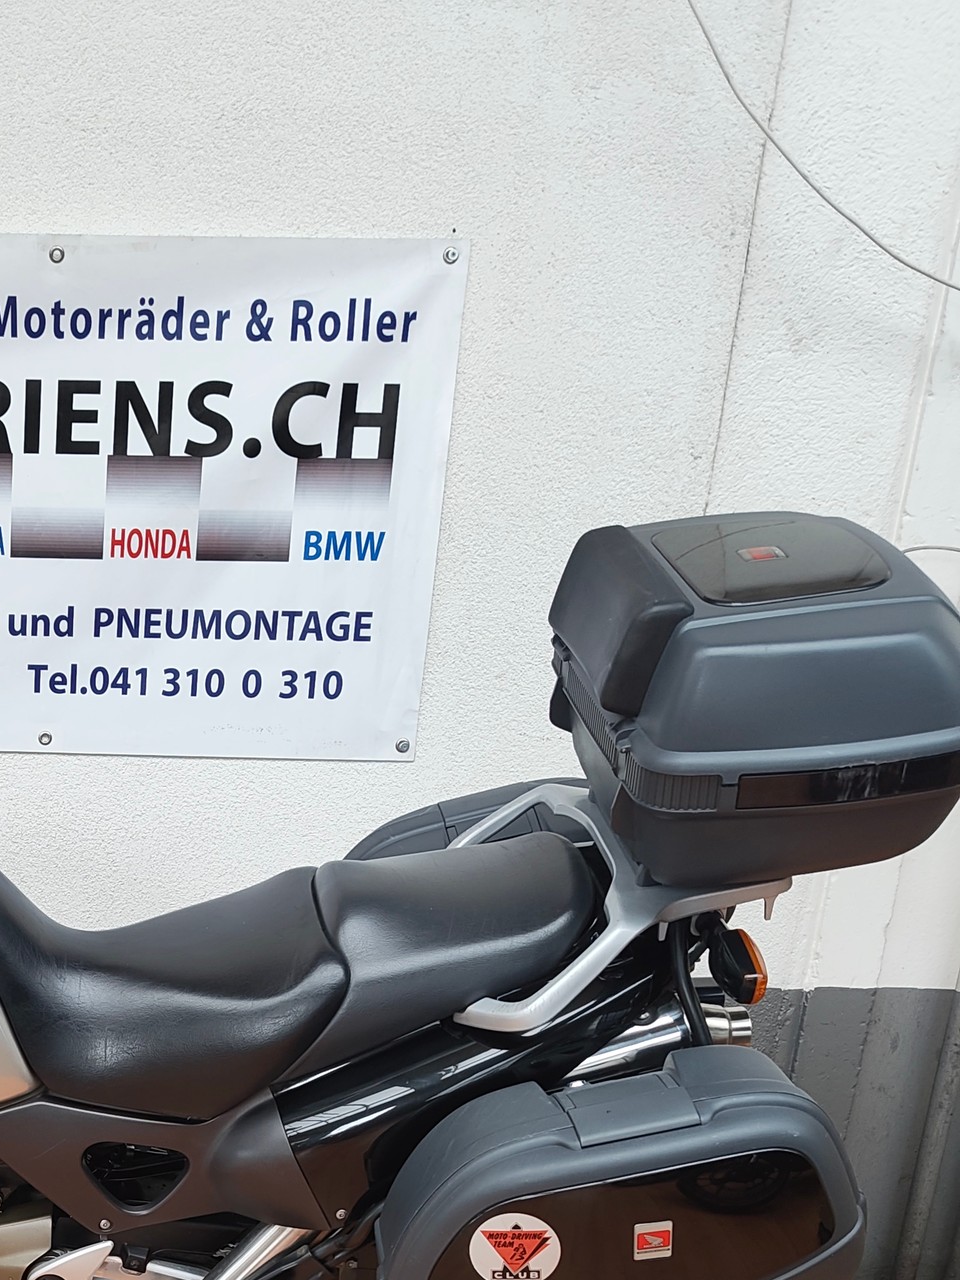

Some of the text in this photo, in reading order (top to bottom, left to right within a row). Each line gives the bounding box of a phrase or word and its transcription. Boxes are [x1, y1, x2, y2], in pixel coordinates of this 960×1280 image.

[245, 298, 274, 342] &
[290, 297, 418, 343] Roller
[110, 528, 192, 560] HONDA
[303, 530, 386, 562] BMW
[8, 605, 75, 638] und
[93, 607, 374, 642] PNEUMONTAGE
[161, 667, 225, 698] 310
[242, 669, 262, 699] 0
[278, 669, 343, 700] 310
[494, 1271, 539, 1279] CLUB
